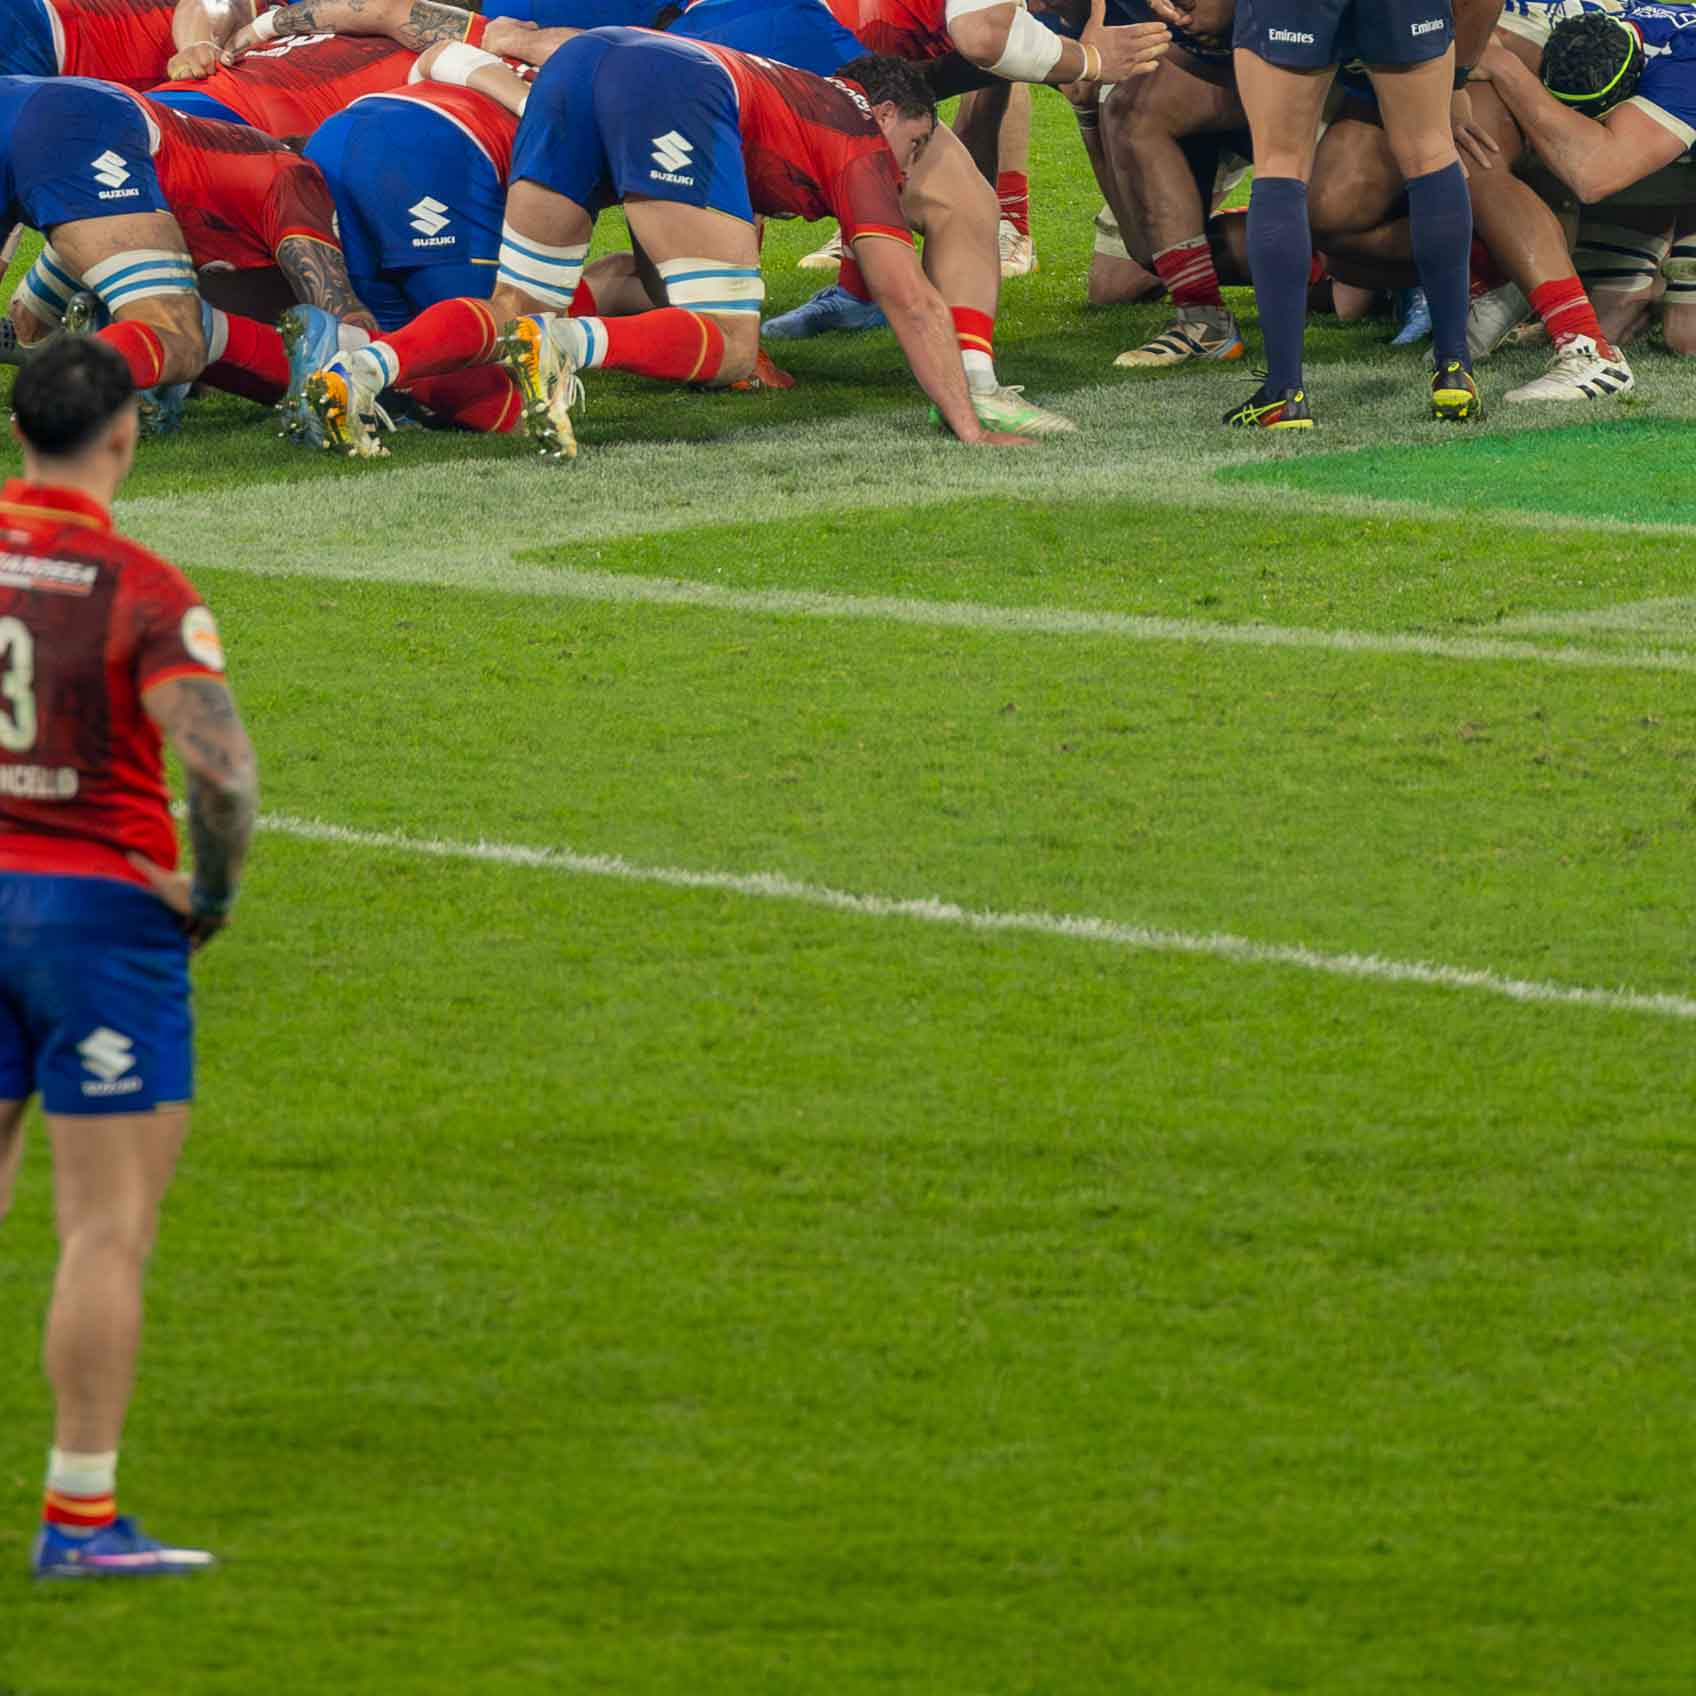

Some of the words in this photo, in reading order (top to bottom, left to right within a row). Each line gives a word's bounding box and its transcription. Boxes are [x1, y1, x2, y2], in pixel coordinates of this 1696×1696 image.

[1268, 27, 1315, 45] Emirates
[1410, 17, 1445, 37] Emirates
[649, 169, 694, 187] SUZUKI
[411, 235, 456, 249] SUZUKI
